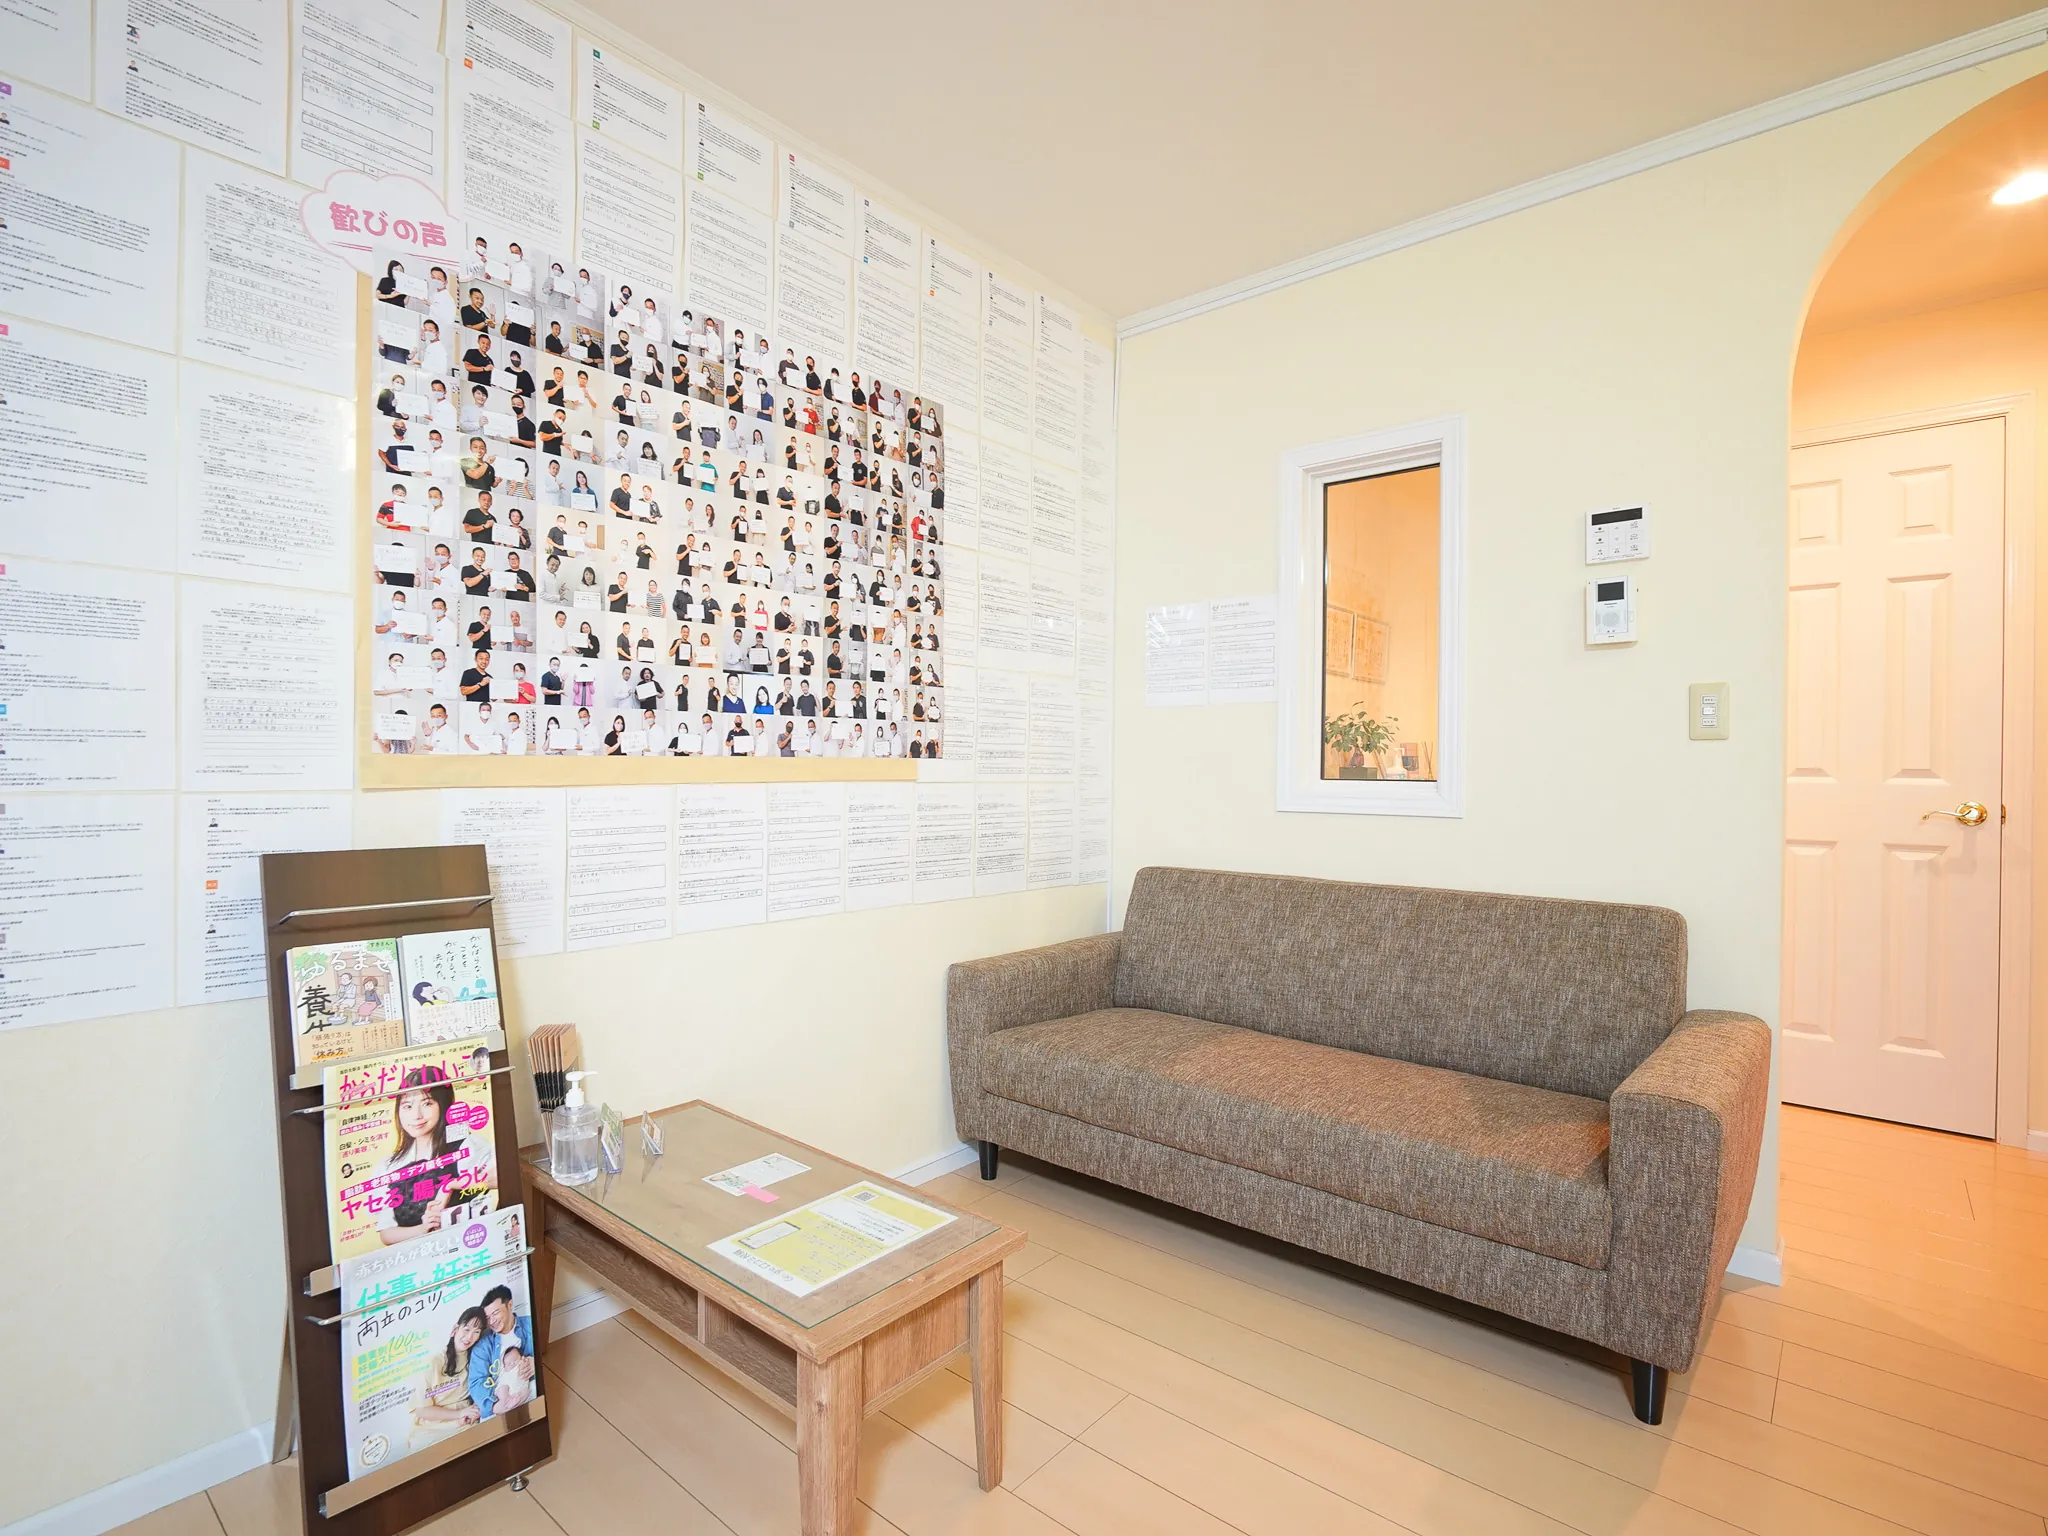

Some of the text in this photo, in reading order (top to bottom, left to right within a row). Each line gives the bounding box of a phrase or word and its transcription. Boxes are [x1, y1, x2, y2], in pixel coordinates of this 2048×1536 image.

[329, 201, 447, 248] 歓びの声
[302, 949, 391, 981] ゆるませ
[481, 1082, 488, 1091] 4
[357, 1291, 443, 1346] 両立のコツ
